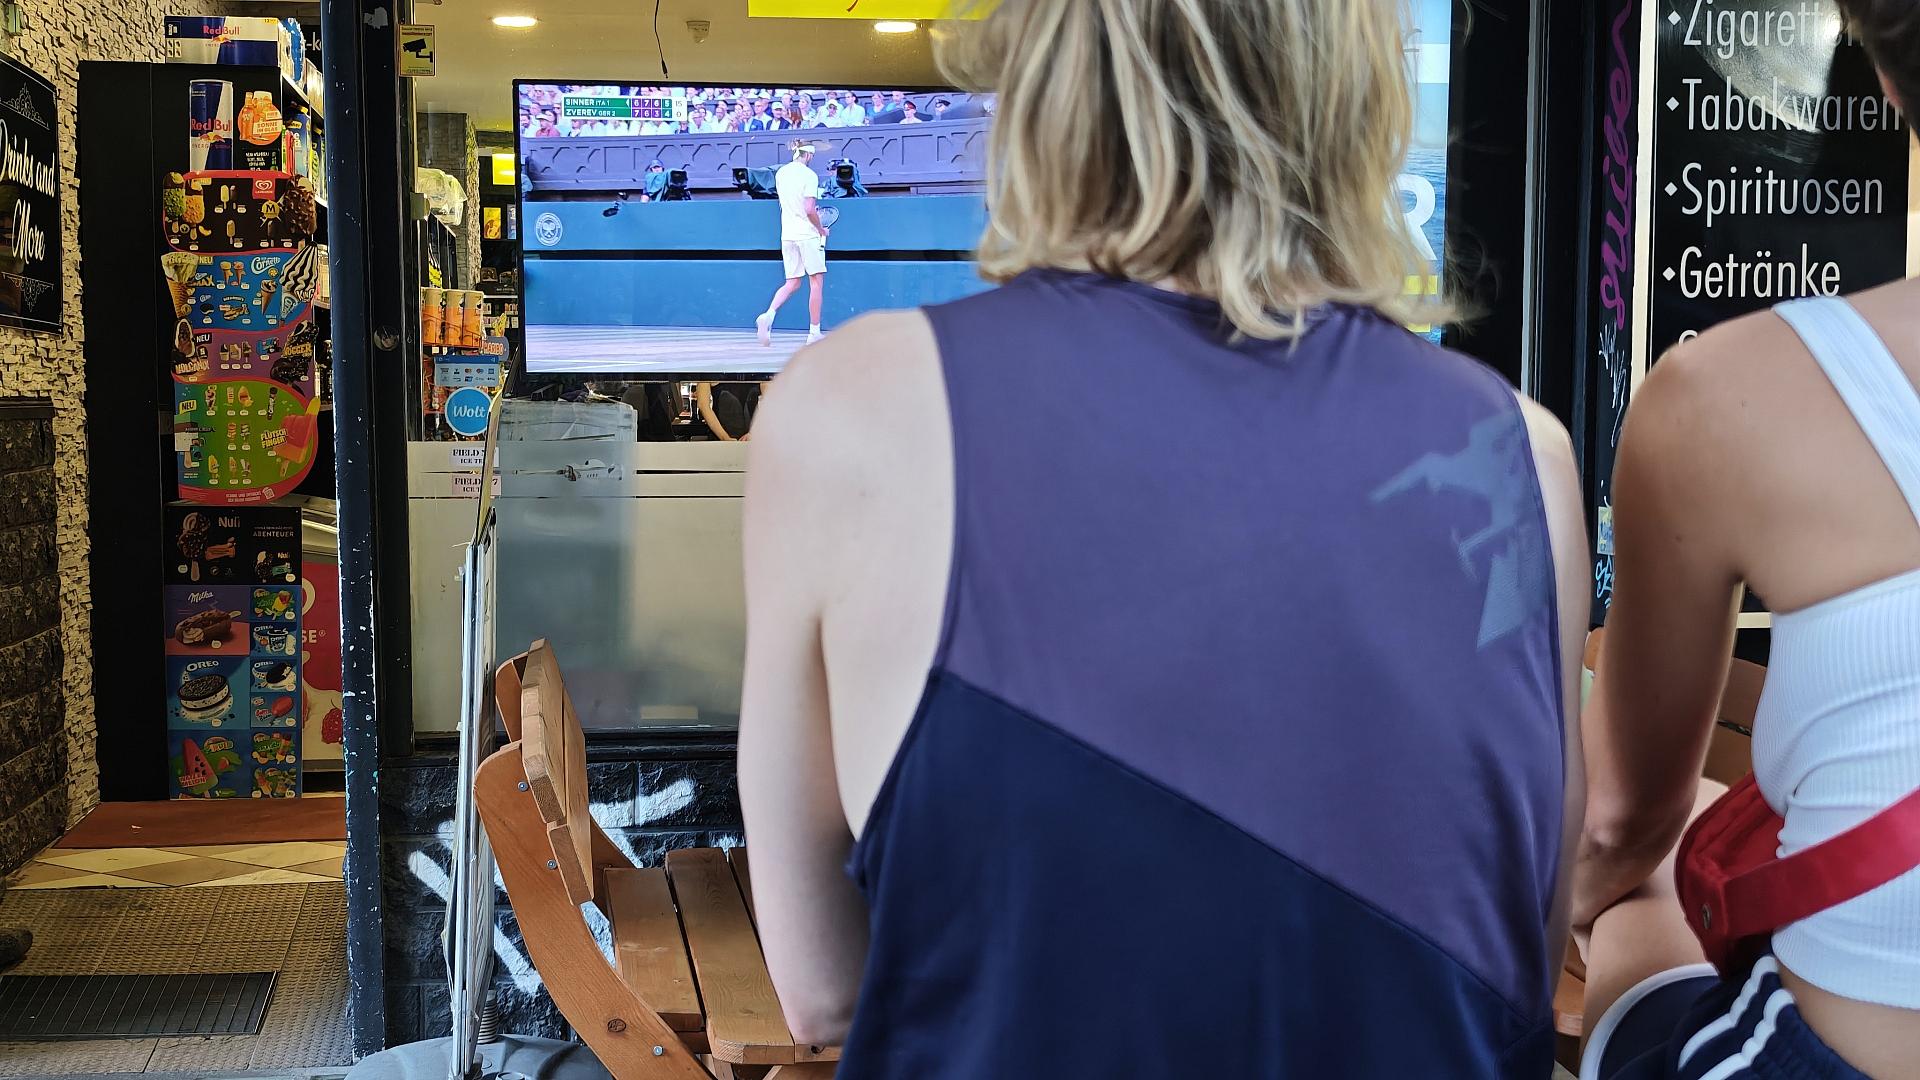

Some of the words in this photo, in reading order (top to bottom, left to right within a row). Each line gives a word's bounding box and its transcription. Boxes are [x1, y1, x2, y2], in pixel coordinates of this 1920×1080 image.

[203, 25, 222, 34] Red
[223, 26, 240, 36] Bull
[565, 98, 595, 106] SINNER
[644, 99, 650, 107] 7
[664, 99, 670, 107] 5
[1682, 76, 1900, 131] Tabakwaren
[566, 108, 597, 116] ZVEREV
[634, 109, 640, 117] 7
[654, 110, 660, 118] 3
[664, 110, 670, 118] 4
[191, 118, 212, 131] Red
[0, 118, 34, 188] Drinks
[36, 152, 56, 198] and
[1681, 162, 1883, 228] Spirituosen
[12, 198, 46, 264] More
[251, 256, 281, 275] Cornetto
[1679, 243, 1841, 298] Getränke
[196, 333, 211, 343] NEU
[453, 405, 486, 418] Wolt
[454, 477, 481, 485] FIELD
[188, 590, 214, 603] Milka
[186, 660, 219, 672] OREO
